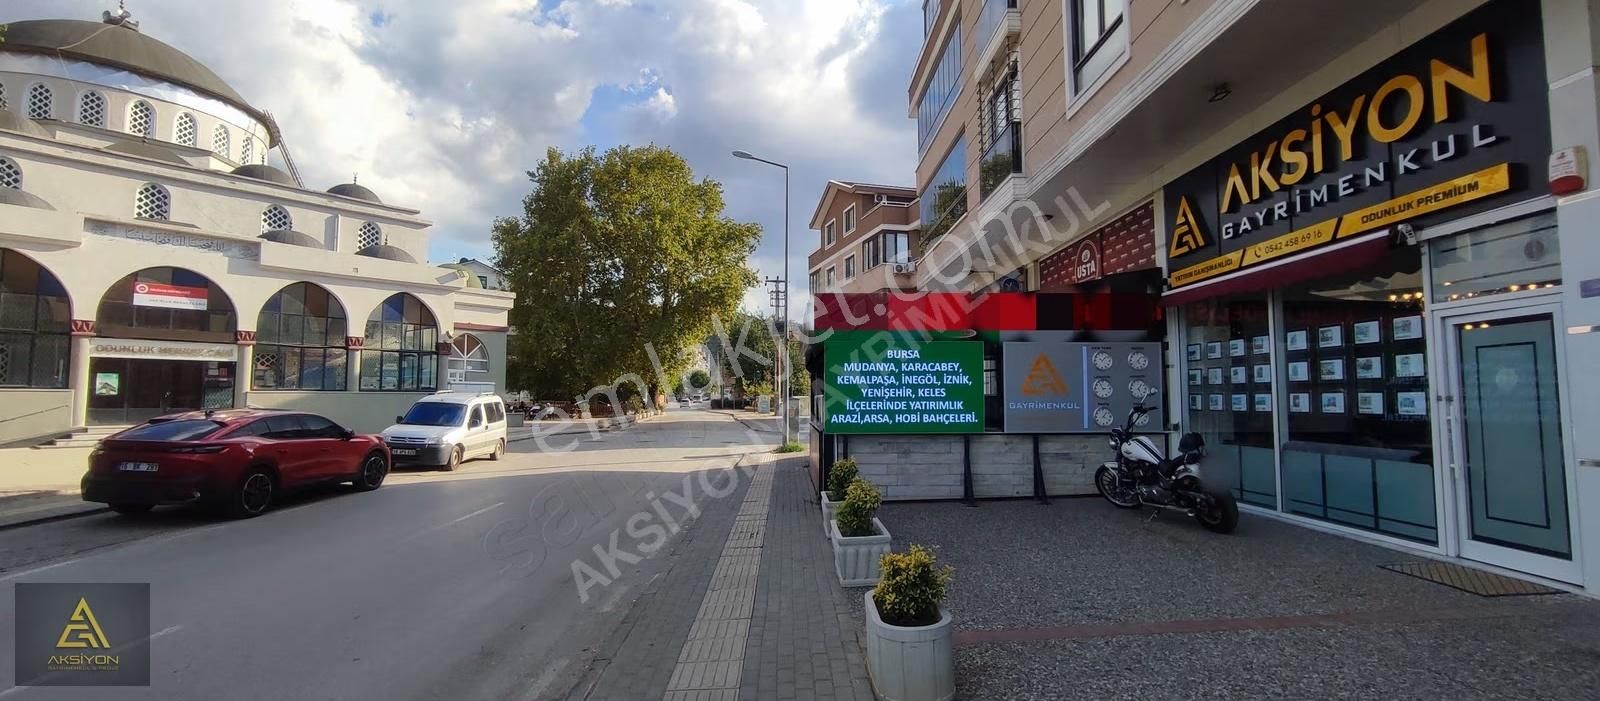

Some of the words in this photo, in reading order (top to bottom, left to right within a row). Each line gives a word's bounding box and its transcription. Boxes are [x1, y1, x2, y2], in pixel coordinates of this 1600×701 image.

[1220, 32, 1492, 214] AKSİYON
[1222, 123, 1497, 240] GAYRİMENKUL
[1361, 201, 1414, 224] ODUNLUK
[1416, 180, 1480, 208] PREMİUM
[1284, 238, 1299, 249] 458
[1301, 234, 1312, 244] 69
[1313, 230, 1323, 240] 16
[1076, 260, 1096, 279] USTA
[887, 349, 920, 359] BURSA
[843, 362, 899, 373] MUDANYA,
[901, 362, 963, 373] KARACABEY,
[837, 375, 899, 386] KEMALPAŞA,
[901, 373, 941, 386] İNEGÖL,
[943, 373, 972, 386] İZNİK,
[861, 387, 916, 399] YENİŞEHİR,
[918, 388, 946, 398] KELES
[846, 400, 907, 412] İLÇELERİNDE
[908, 401, 964, 410] YATIRIMLIK
[895, 412, 921, 423] HOBİ
[922, 412, 978, 425] BAHÇELERİ.
